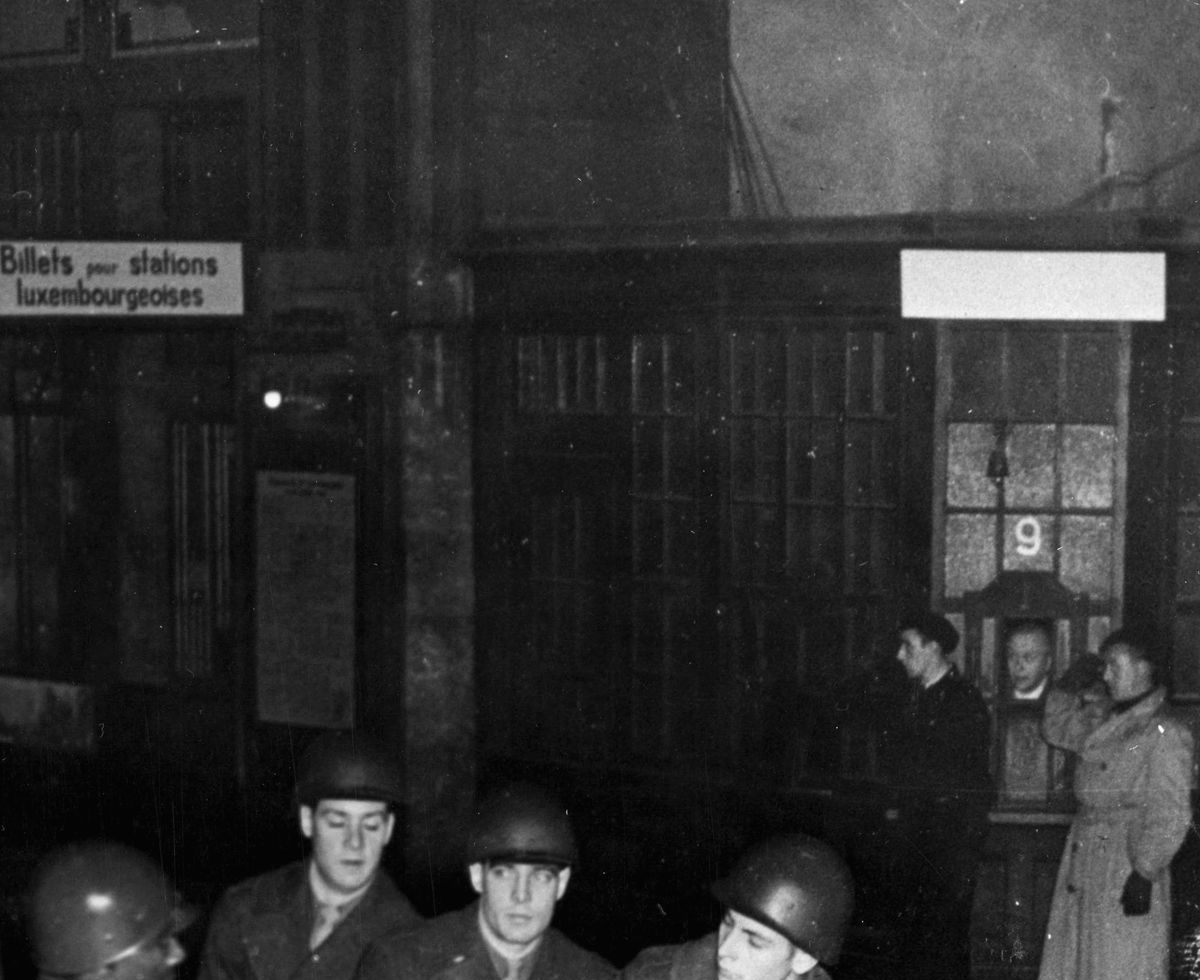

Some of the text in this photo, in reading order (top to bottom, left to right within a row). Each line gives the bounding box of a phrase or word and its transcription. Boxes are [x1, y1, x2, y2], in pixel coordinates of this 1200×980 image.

[0, 244, 218, 278] Billets pour stations
[17, 278, 204, 311] luxembourgeoises
[1015, 516, 1041, 556] 9
